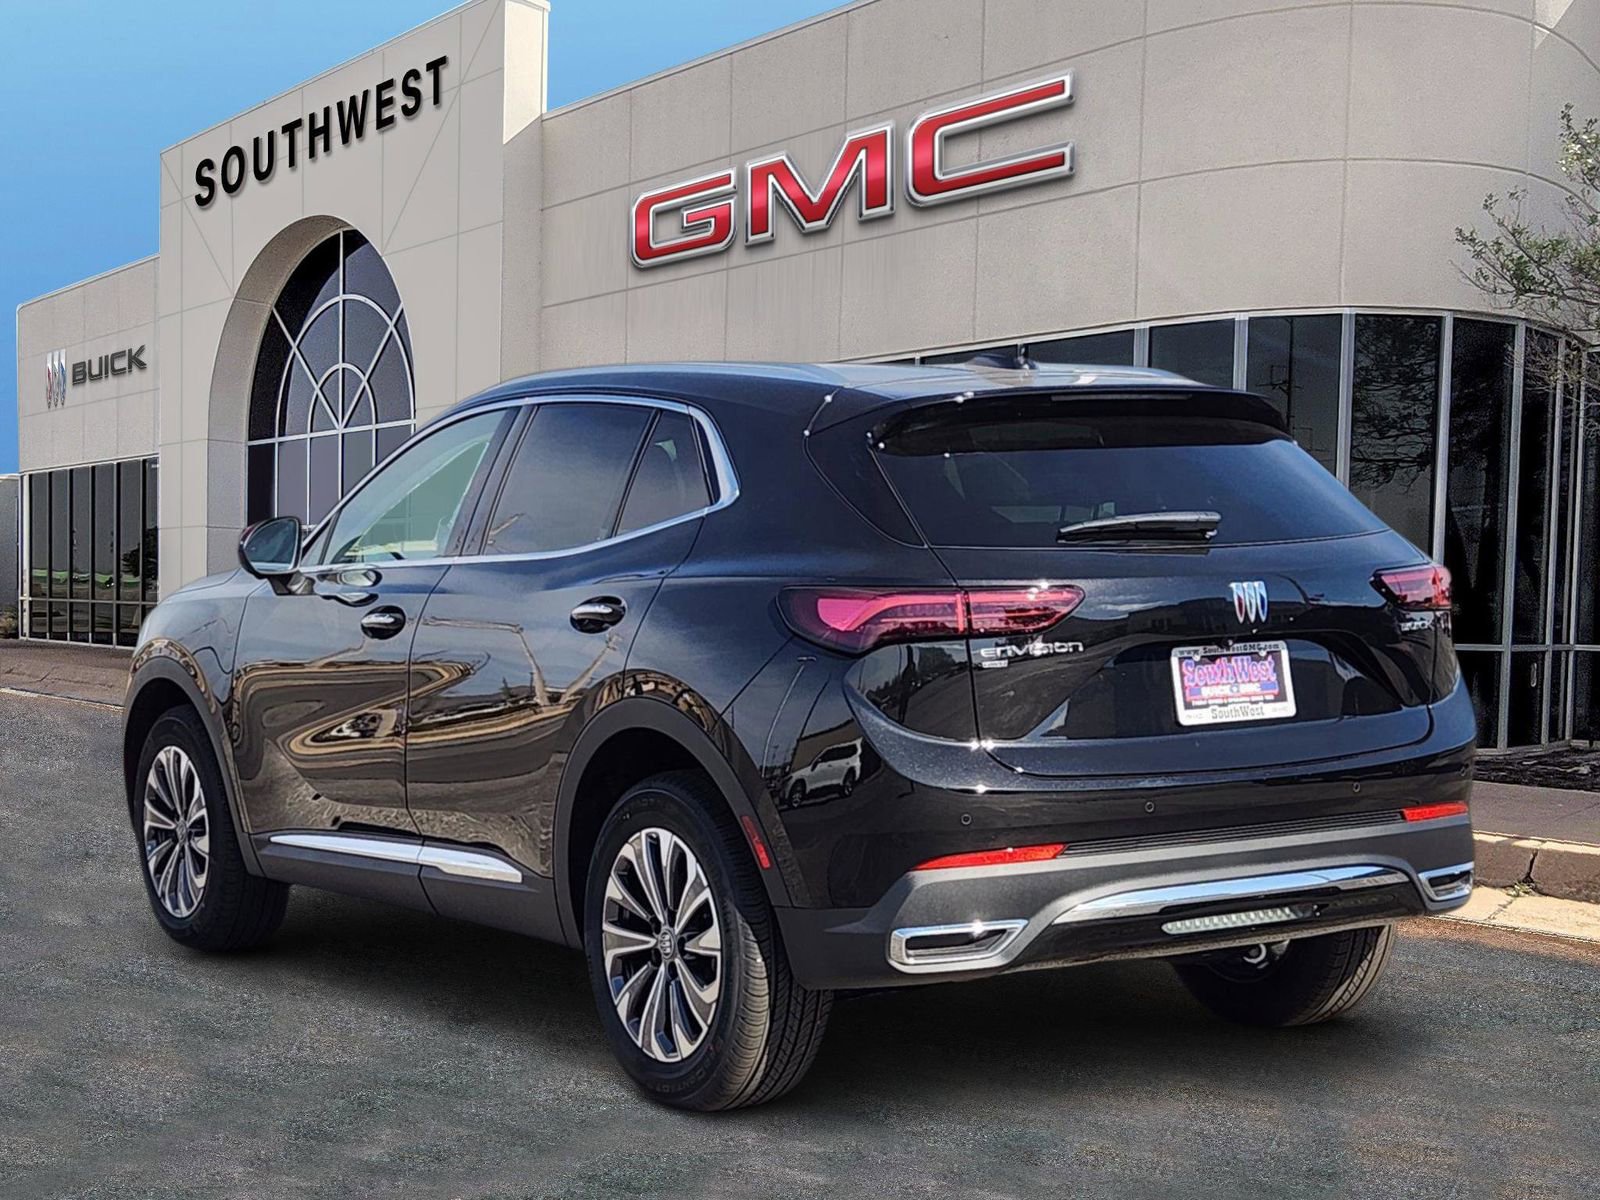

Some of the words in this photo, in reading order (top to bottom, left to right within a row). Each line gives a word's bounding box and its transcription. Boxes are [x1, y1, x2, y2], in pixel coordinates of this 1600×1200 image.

[194, 56, 449, 207] SOUTHWEST
[630, 69, 1076, 268] GMC
[72, 344, 147, 385] BUICK
[1182, 655, 1277, 687] SouthWest
[1211, 706, 1265, 719] SouthWest
